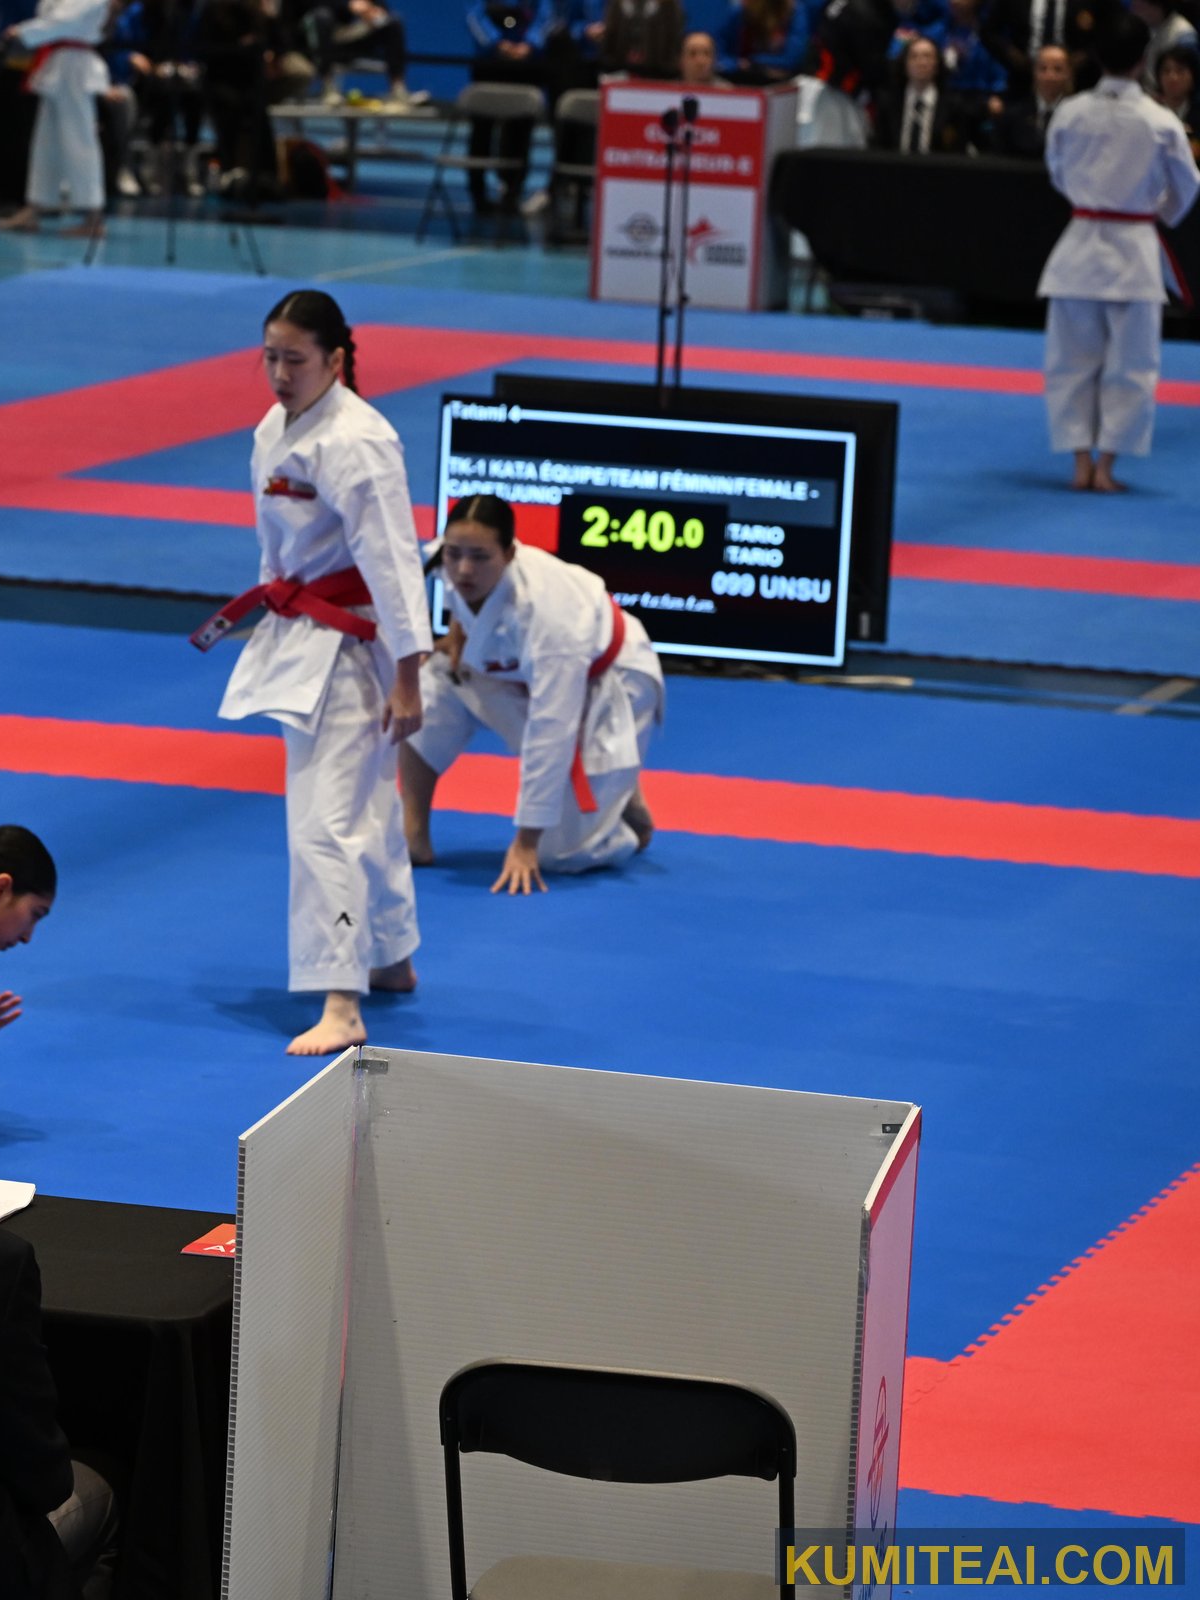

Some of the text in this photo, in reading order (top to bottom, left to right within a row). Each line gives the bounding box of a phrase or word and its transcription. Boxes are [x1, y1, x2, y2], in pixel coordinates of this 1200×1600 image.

[644, 123, 720, 145] CCH
[451, 400, 507, 422] Tatami
[449, 455, 486, 477] TK-1
[488, 459, 538, 481] KATA
[580, 505, 704, 553] 2:40.0
[759, 574, 831, 603] UNSU
